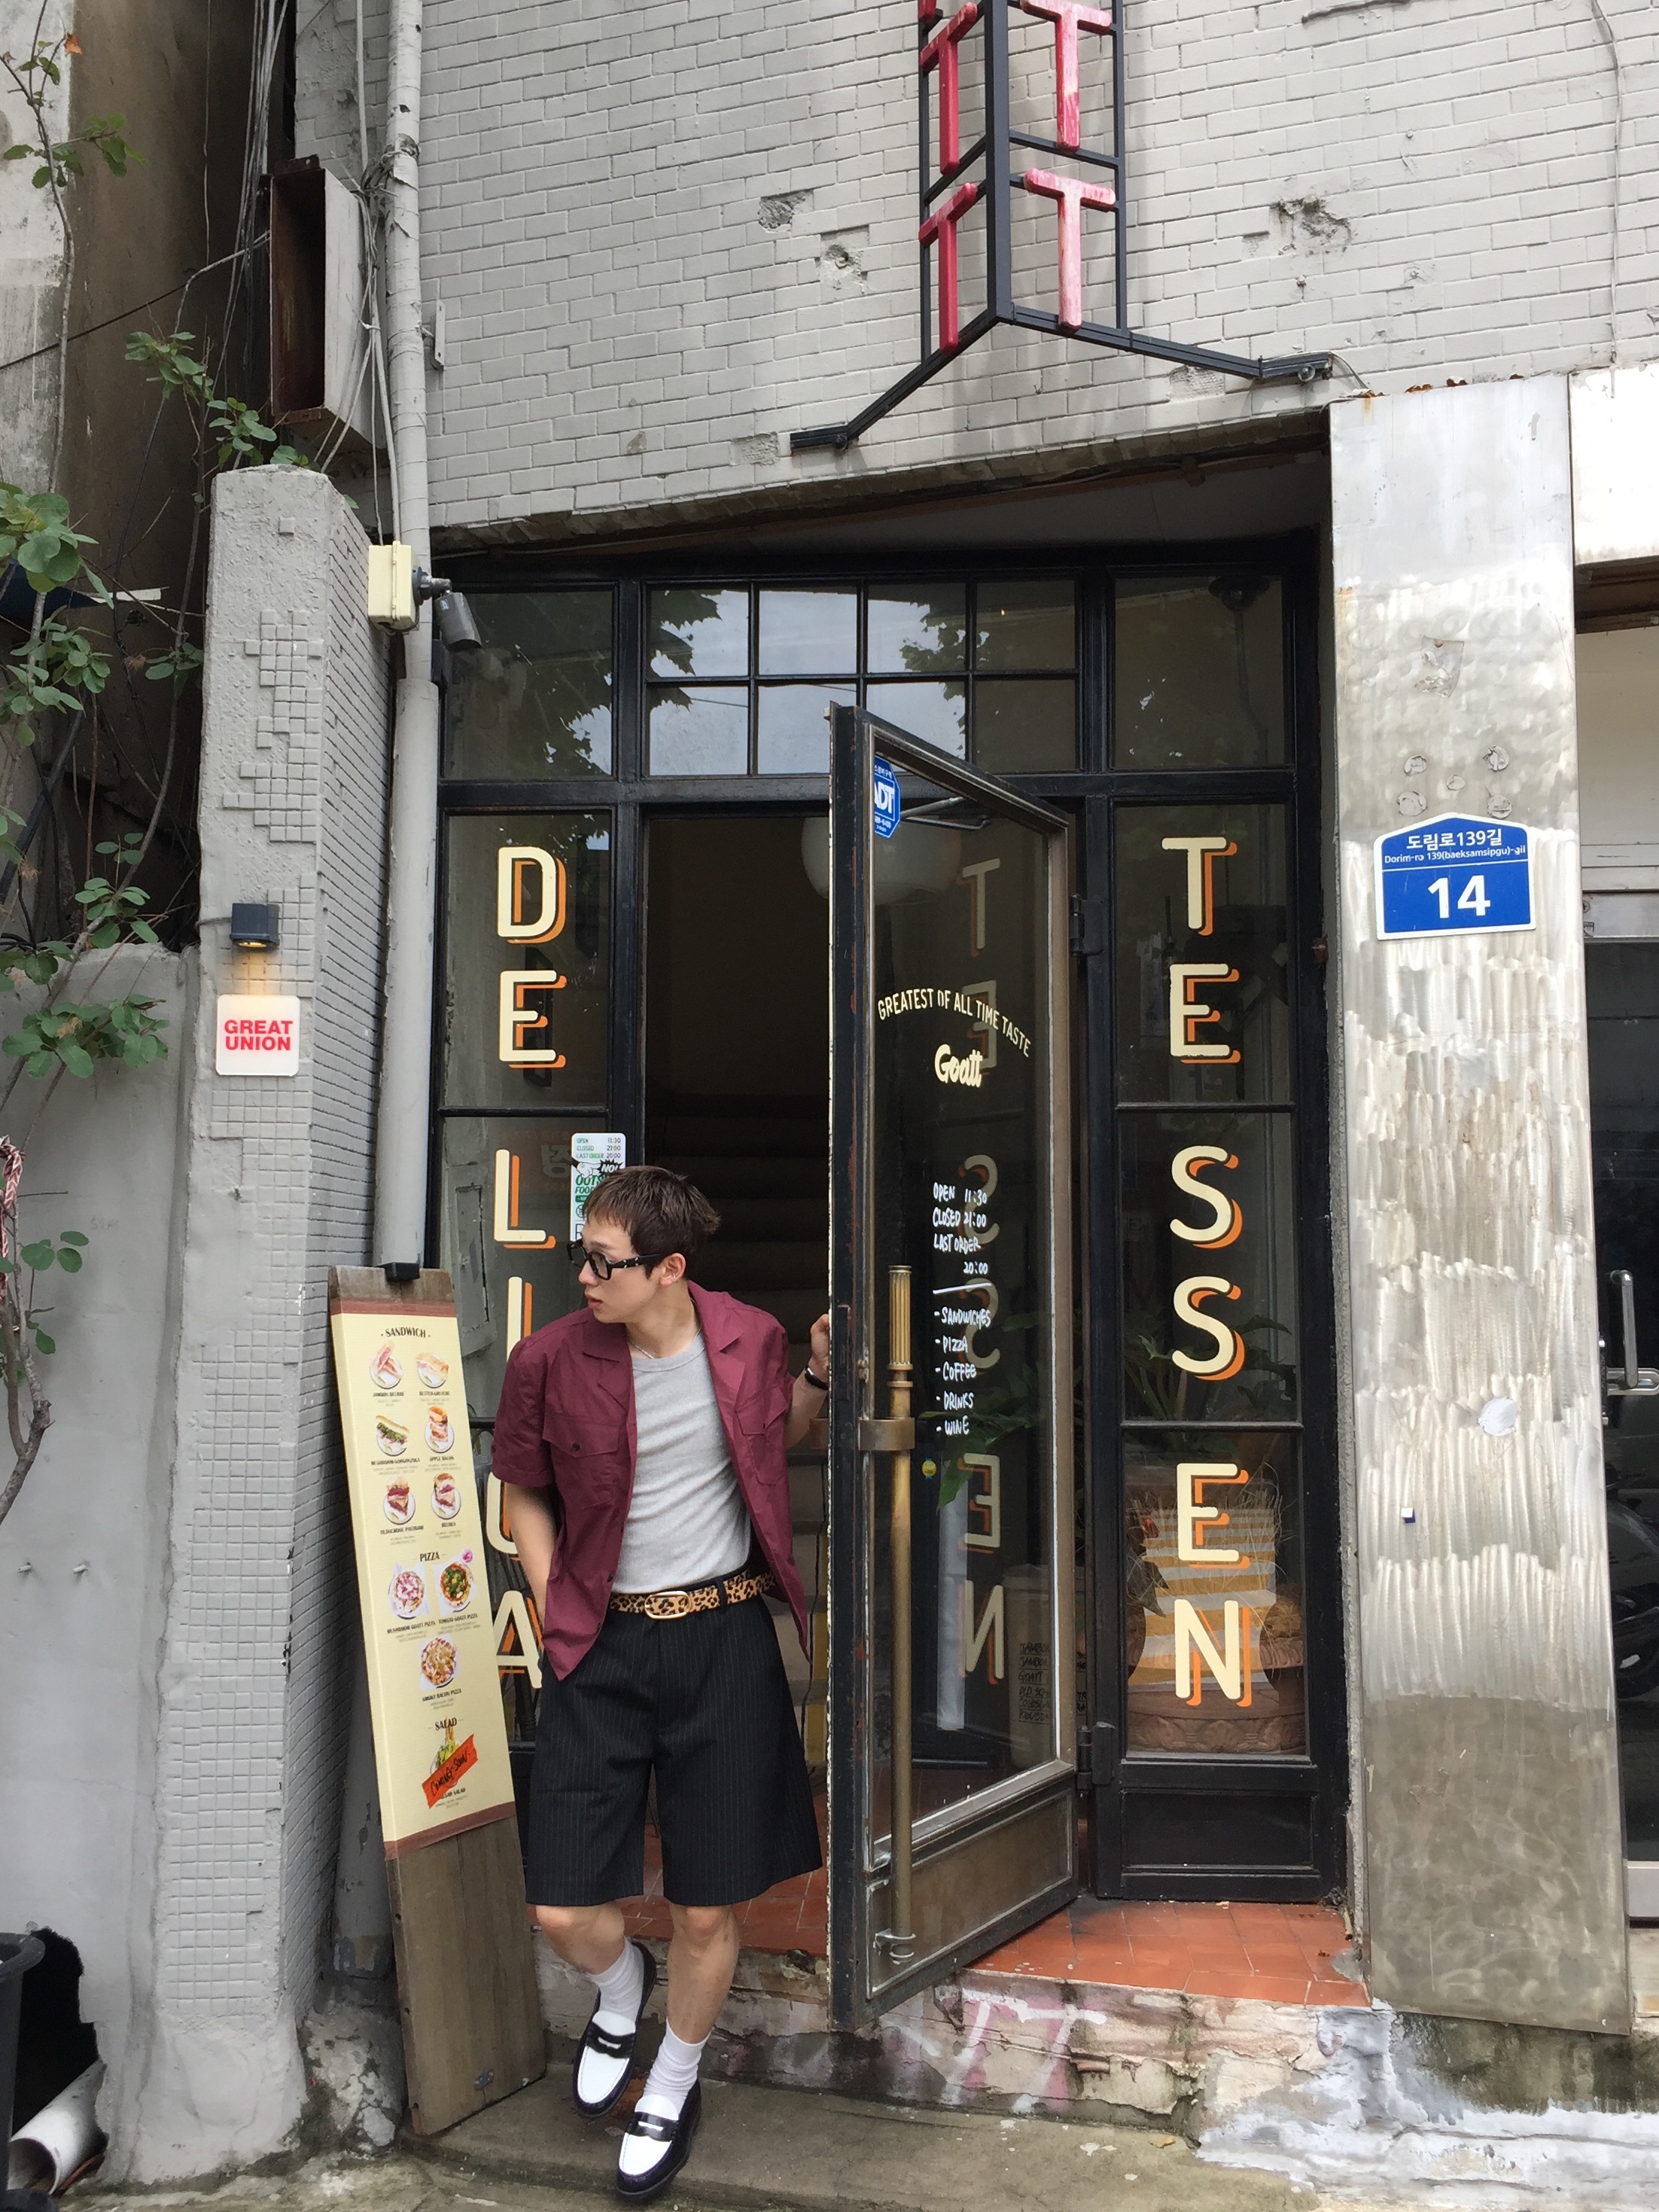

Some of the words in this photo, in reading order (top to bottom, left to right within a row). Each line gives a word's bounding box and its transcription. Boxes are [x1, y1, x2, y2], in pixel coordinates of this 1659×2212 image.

[1406, 828, 1502, 851] 도림로139길
[1384, 854, 1424, 864] Dorim-ro
[1426, 845, 1526, 861] 139(baeksamsipgu)-gil
[1428, 875, 1491, 919] 14
[224, 1019, 294, 1034] GREAT
[878, 989, 934, 1020] GREATEST
[937, 990, 951, 1009] OF
[954, 992, 973, 1016] ALL
[976, 999, 1000, 1030] TIME
[1002, 1016, 1031, 1058] TASTE
[225, 1036, 291, 1050] UNION
[935, 1044, 983, 1088] Goatt
[575, 1175, 605, 1187] OUTS
[933, 1181, 955, 1202] OPEN
[964, 1188, 988, 1206] 11:30
[933, 1206, 960, 1227] CLOSED
[963, 1211, 987, 1228] 21:00
[933, 1233, 954, 1252] LAST
[954, 1235, 982, 1255] ORDER
[963, 1261, 988, 1275] 20:00
[1161, 836, 1247, 1705] TESSEN
[941, 1306, 991, 1330] SANDWICHES
[385, 1327, 426, 1338] SANDWICH
[942, 1335, 968, 1354] PIZZA
[942, 1360, 977, 1382] COFFEE
[943, 1391, 974, 1411] DRINKS
[945, 1415, 970, 1436] WINE
[419, 1552, 440, 1562] PIZZA
[435, 1717, 458, 1731] SALAD
